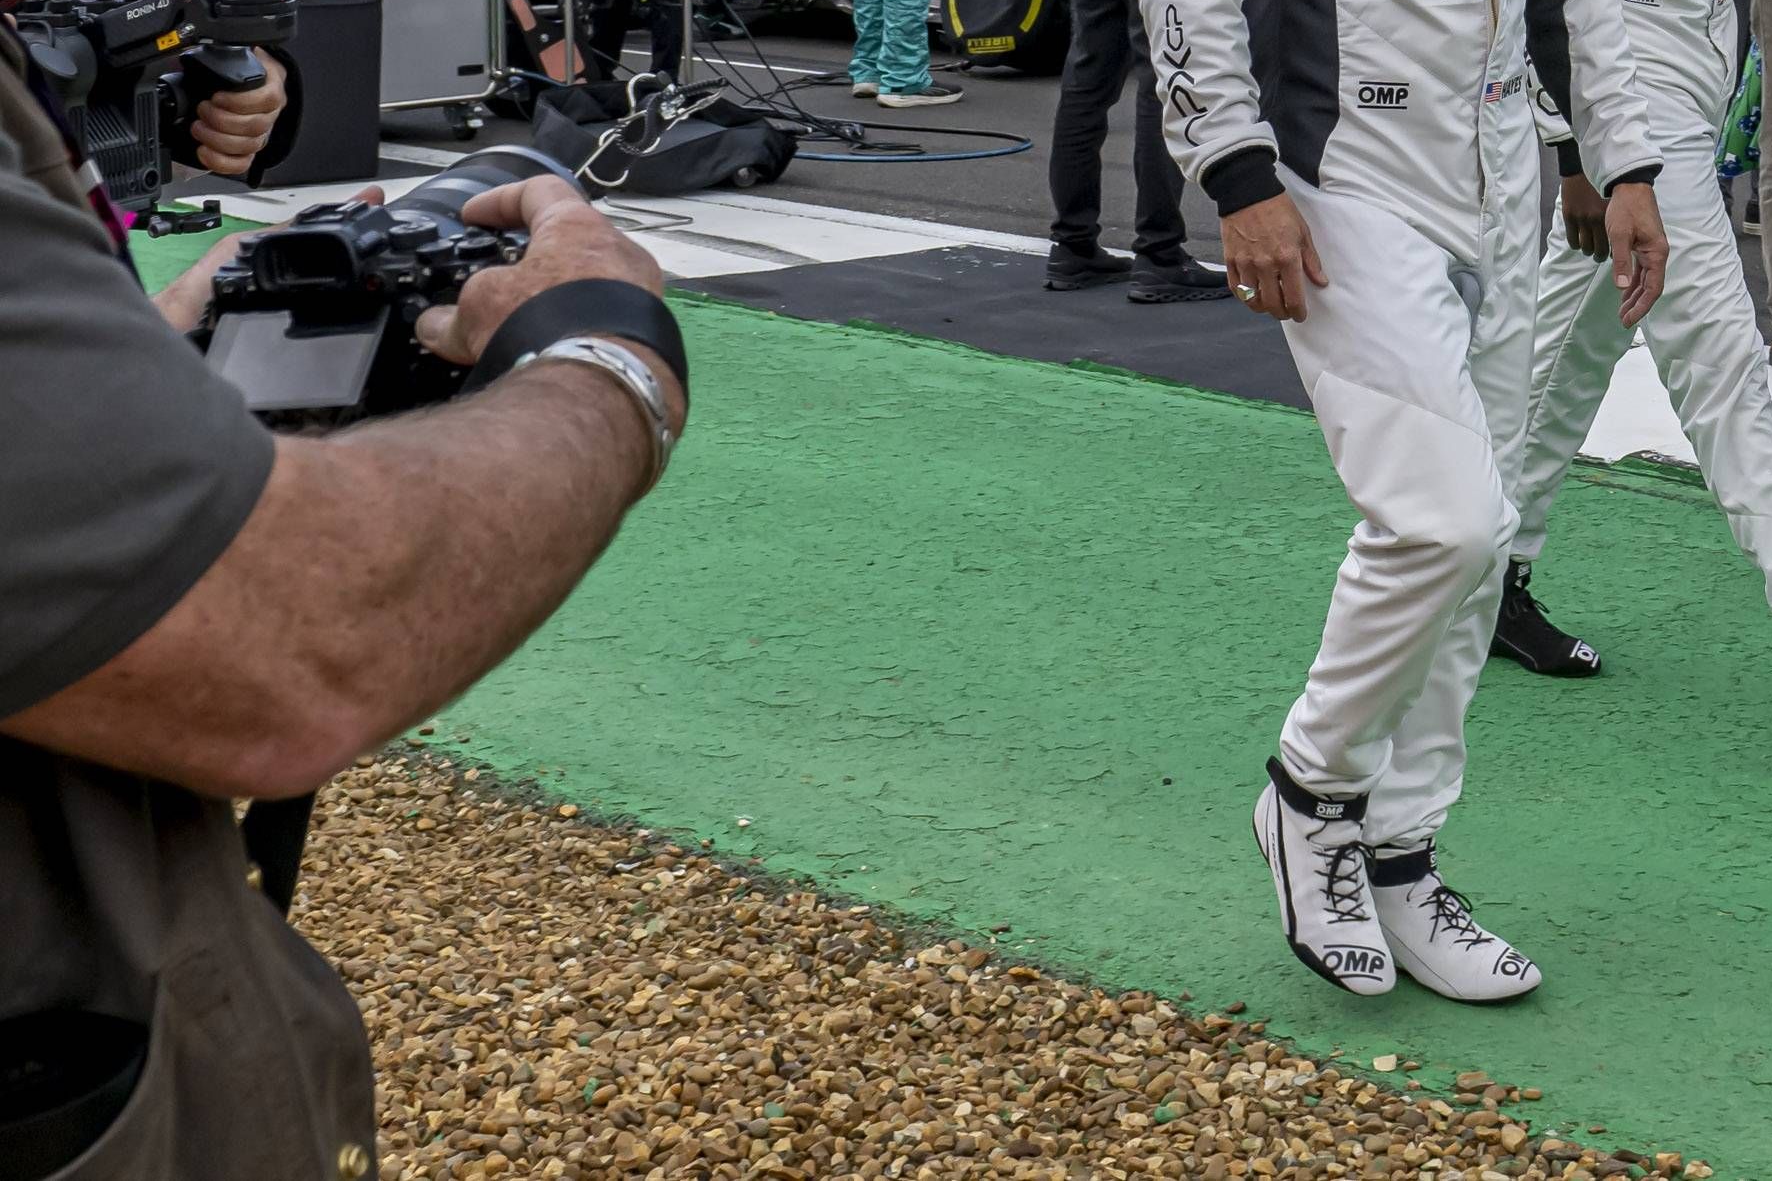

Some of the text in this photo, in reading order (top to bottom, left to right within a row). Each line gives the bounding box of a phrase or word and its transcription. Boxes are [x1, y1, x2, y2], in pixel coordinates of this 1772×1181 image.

[1358, 86, 1408, 105] OMP
[1316, 805, 1344, 815] OMP
[1322, 951, 1384, 975] OMP
